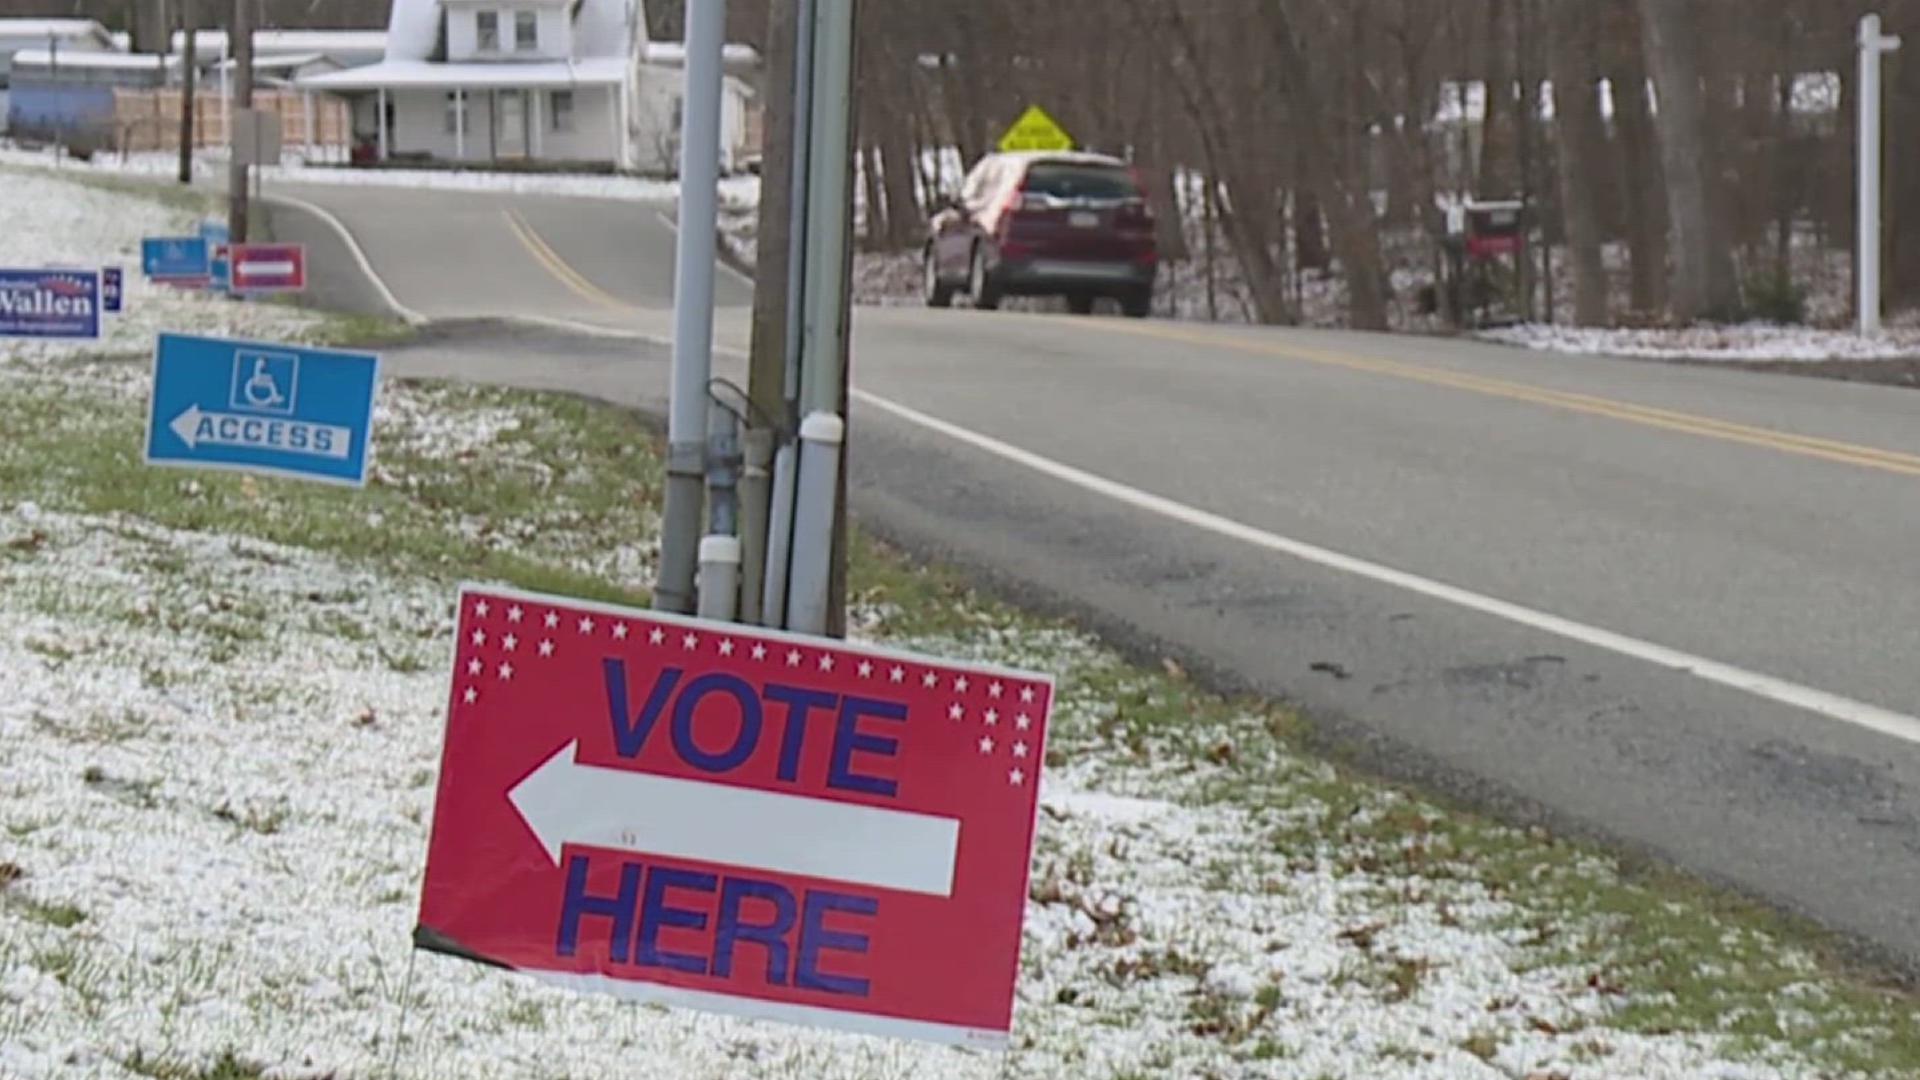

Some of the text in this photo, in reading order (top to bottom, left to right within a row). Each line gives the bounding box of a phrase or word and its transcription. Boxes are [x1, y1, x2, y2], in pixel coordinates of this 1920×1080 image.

[195, 416, 333, 452] ACCESS
[602, 658, 908, 797] VOTE
[555, 855, 879, 997] HERE
